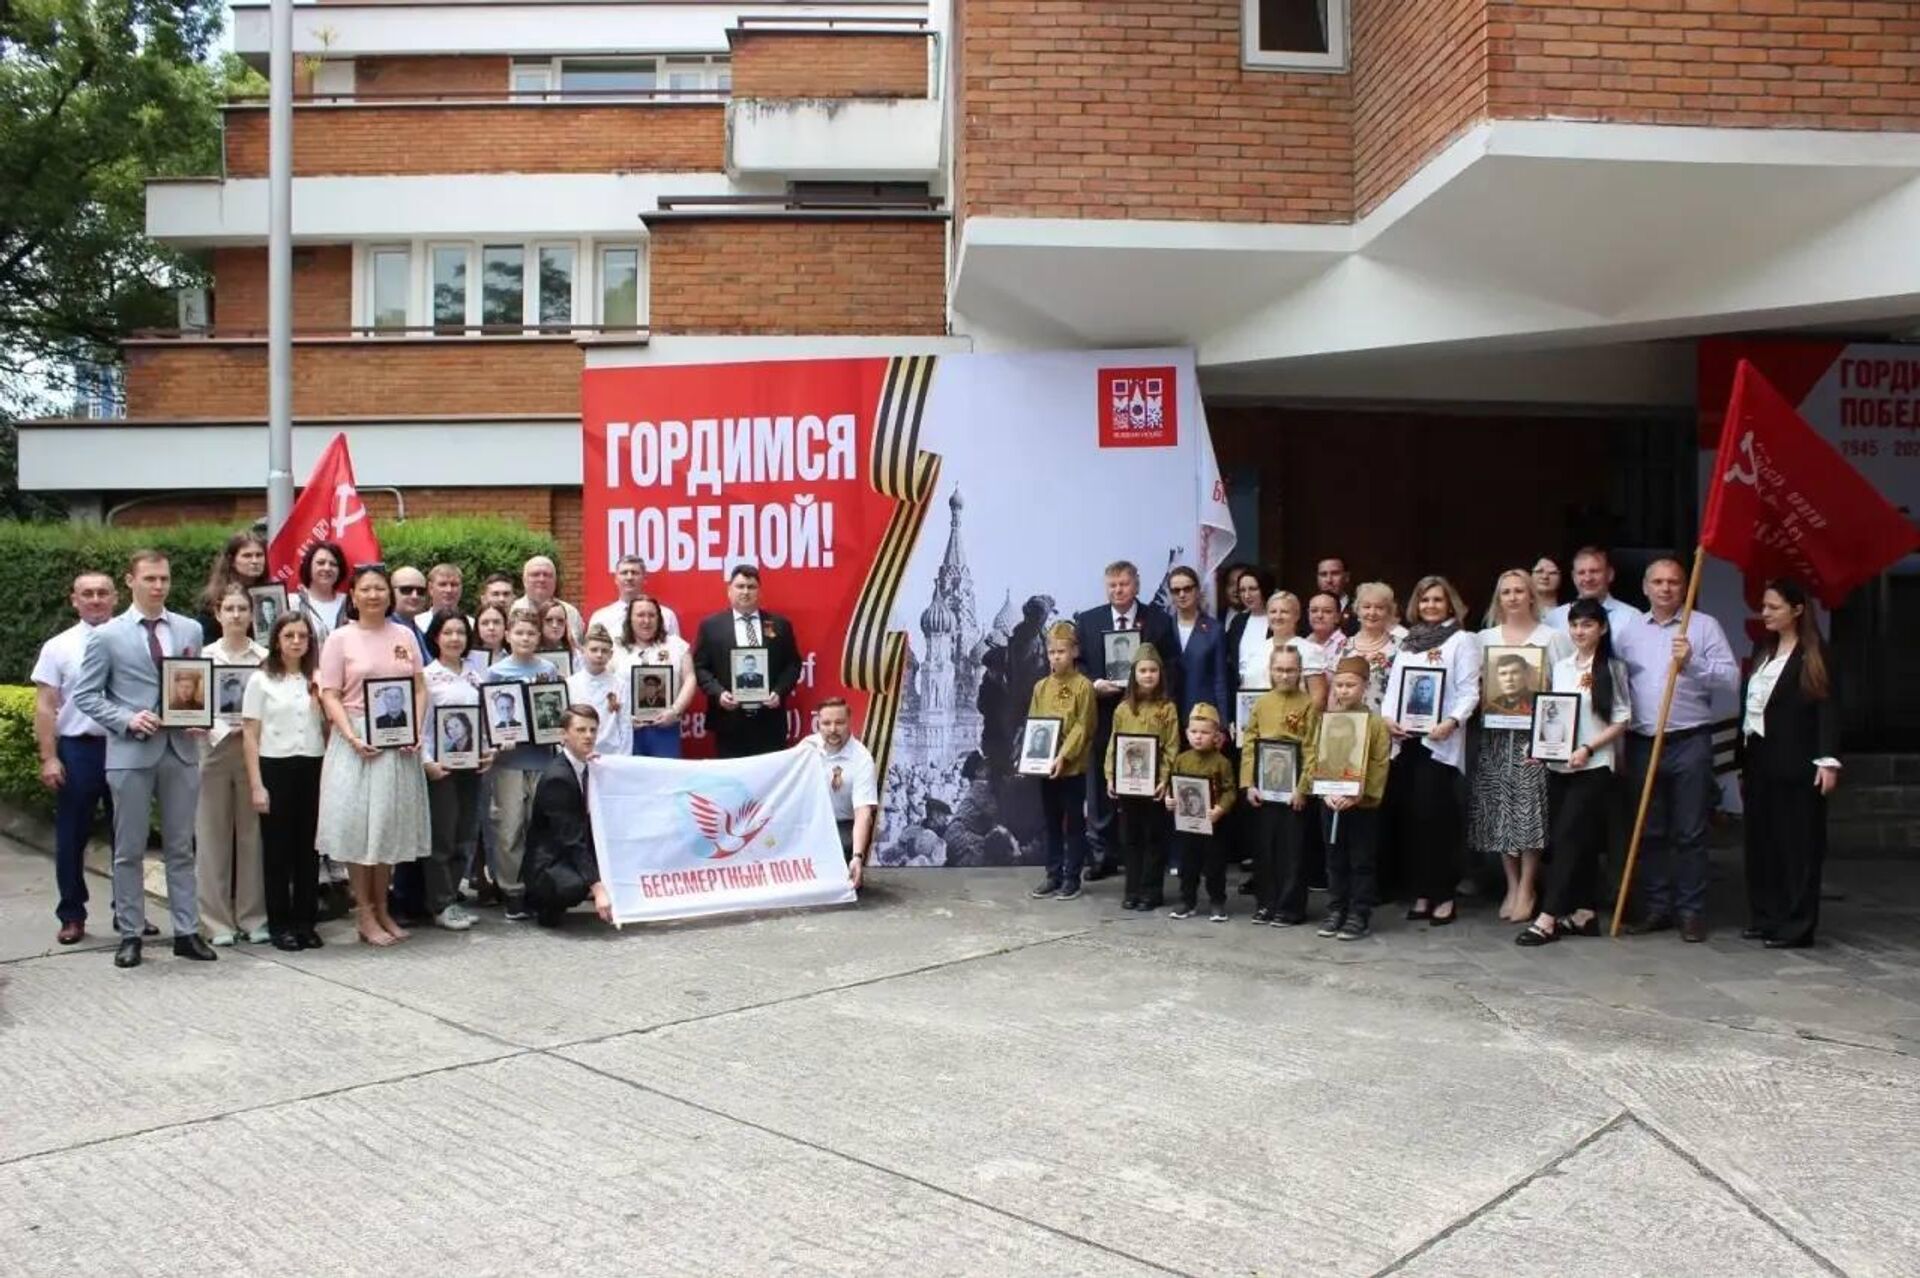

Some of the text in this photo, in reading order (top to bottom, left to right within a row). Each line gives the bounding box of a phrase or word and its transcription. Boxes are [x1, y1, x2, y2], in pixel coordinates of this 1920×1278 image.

[606, 414, 856, 496] ГОРДИМСЯ
[608, 494, 834, 581] ПОБЕДОЙ!
[640, 857, 817, 898] БЕССМЕРТНЫЙ ПОЛК
